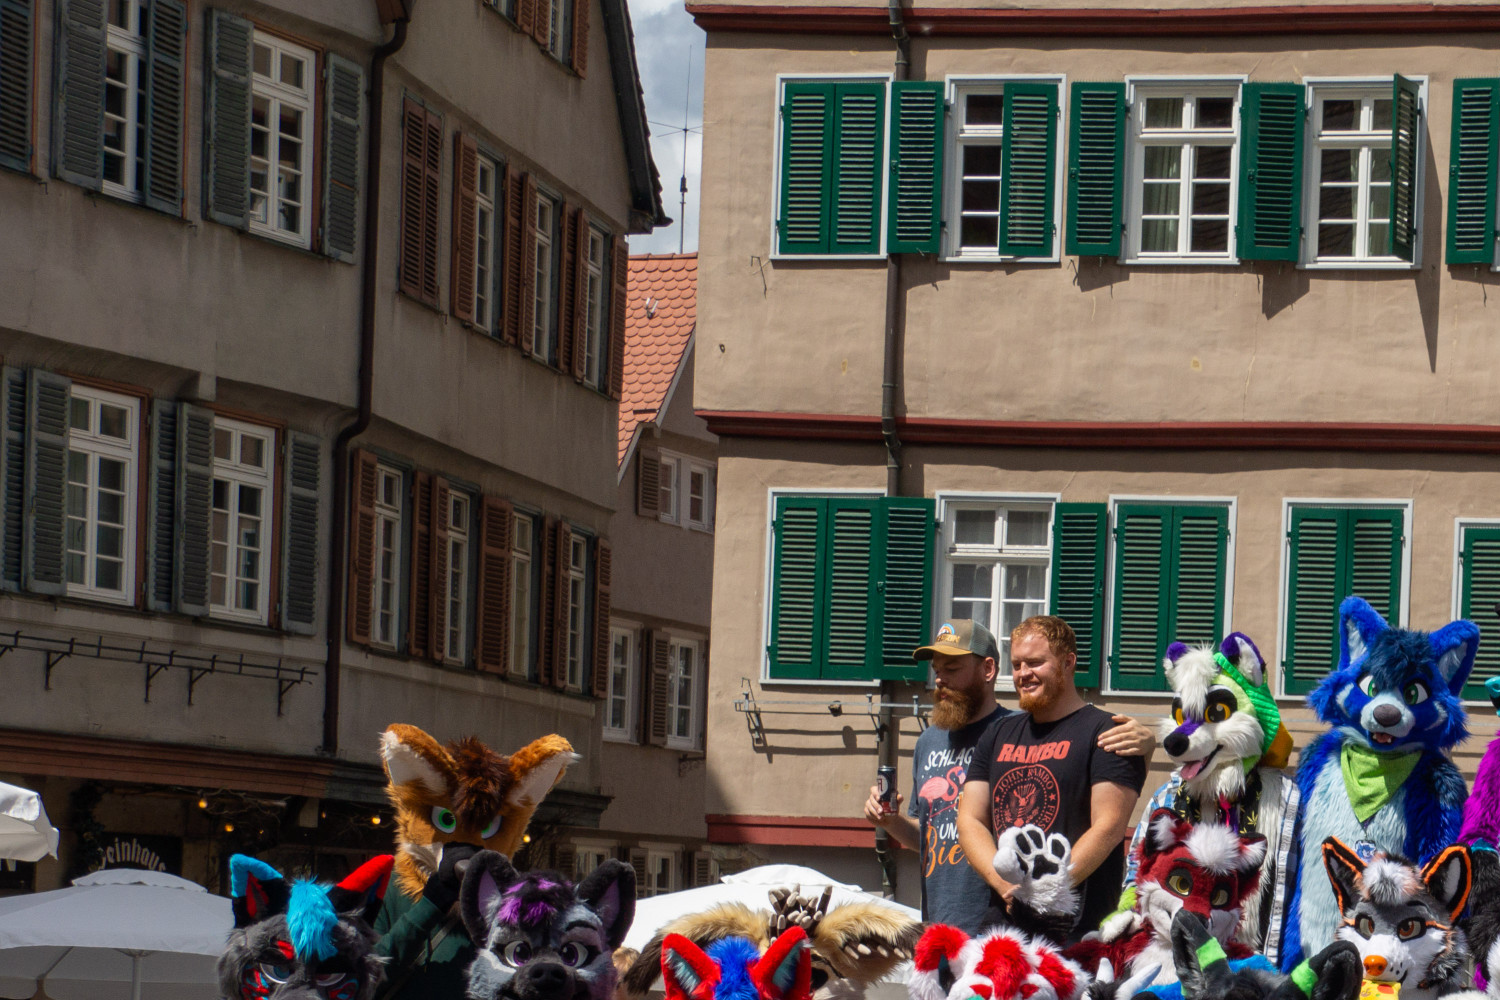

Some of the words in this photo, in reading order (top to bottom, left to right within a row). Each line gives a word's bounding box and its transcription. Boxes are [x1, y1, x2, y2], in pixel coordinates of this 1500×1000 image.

[997, 740, 1070, 764] RAMBO
[998, 769, 1024, 792] JOHN
[1038, 805, 1056, 830] FIRS
[940, 822, 959, 840] UN
[925, 825, 970, 878] Bie
